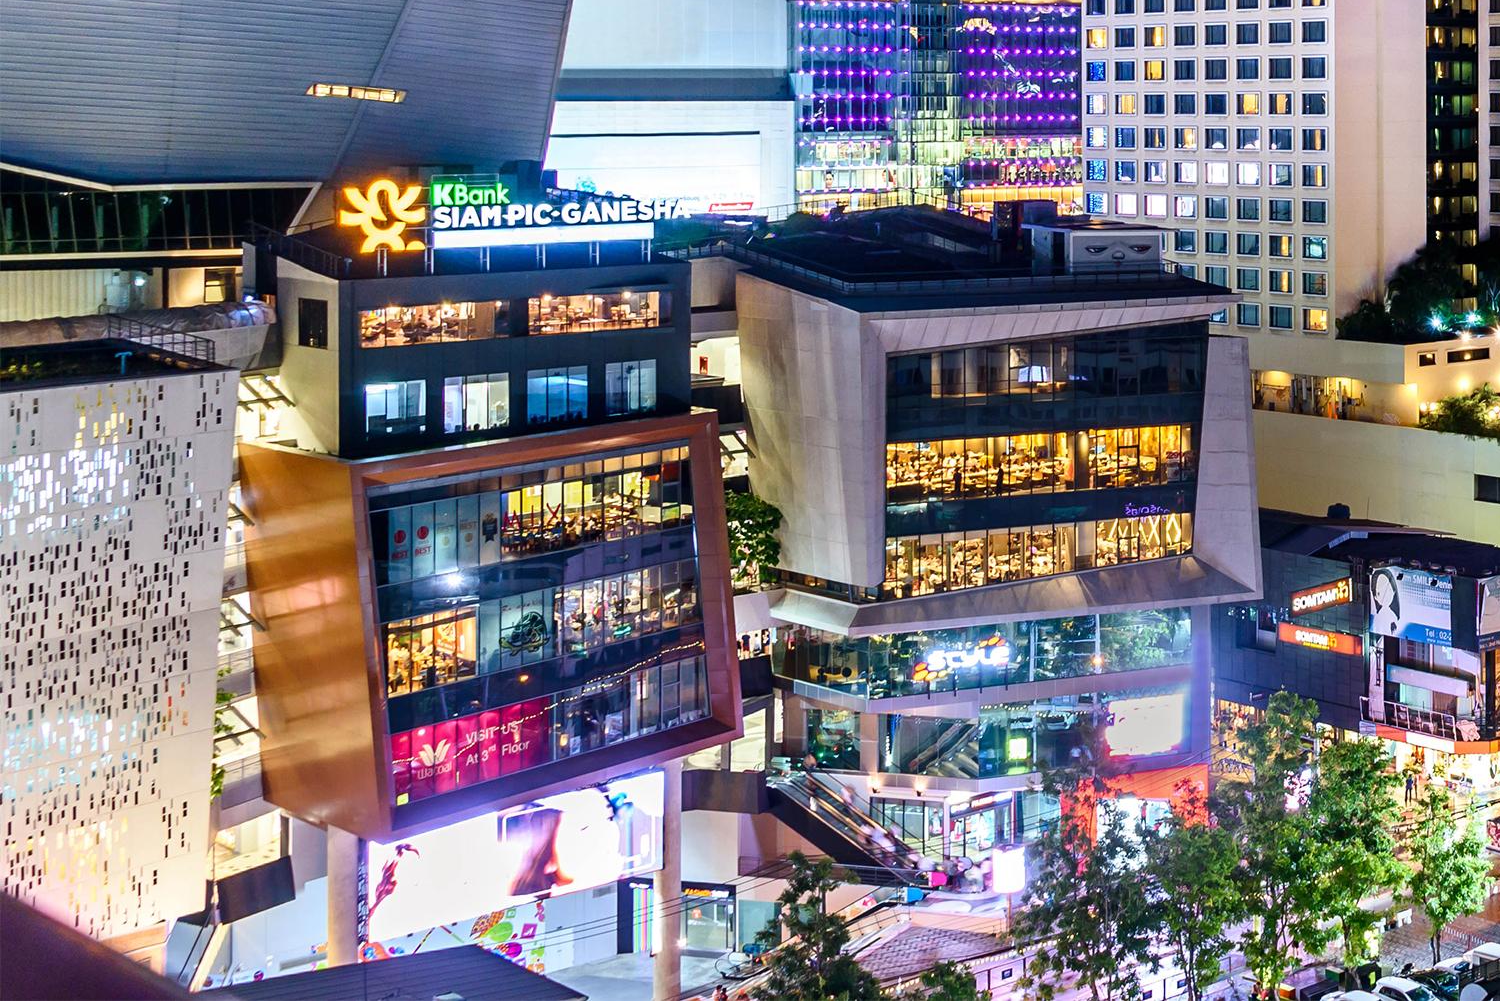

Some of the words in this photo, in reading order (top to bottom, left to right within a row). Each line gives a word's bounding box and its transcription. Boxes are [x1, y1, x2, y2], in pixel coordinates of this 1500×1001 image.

[433, 183, 510, 206] KBank
[414, 546, 432, 557] BEST
[465, 726, 496, 744] VISIT
[502, 721, 518, 735] US
[466, 752, 479, 766] At
[481, 743, 497, 762] 3rd
[501, 739, 531, 756] Floor
